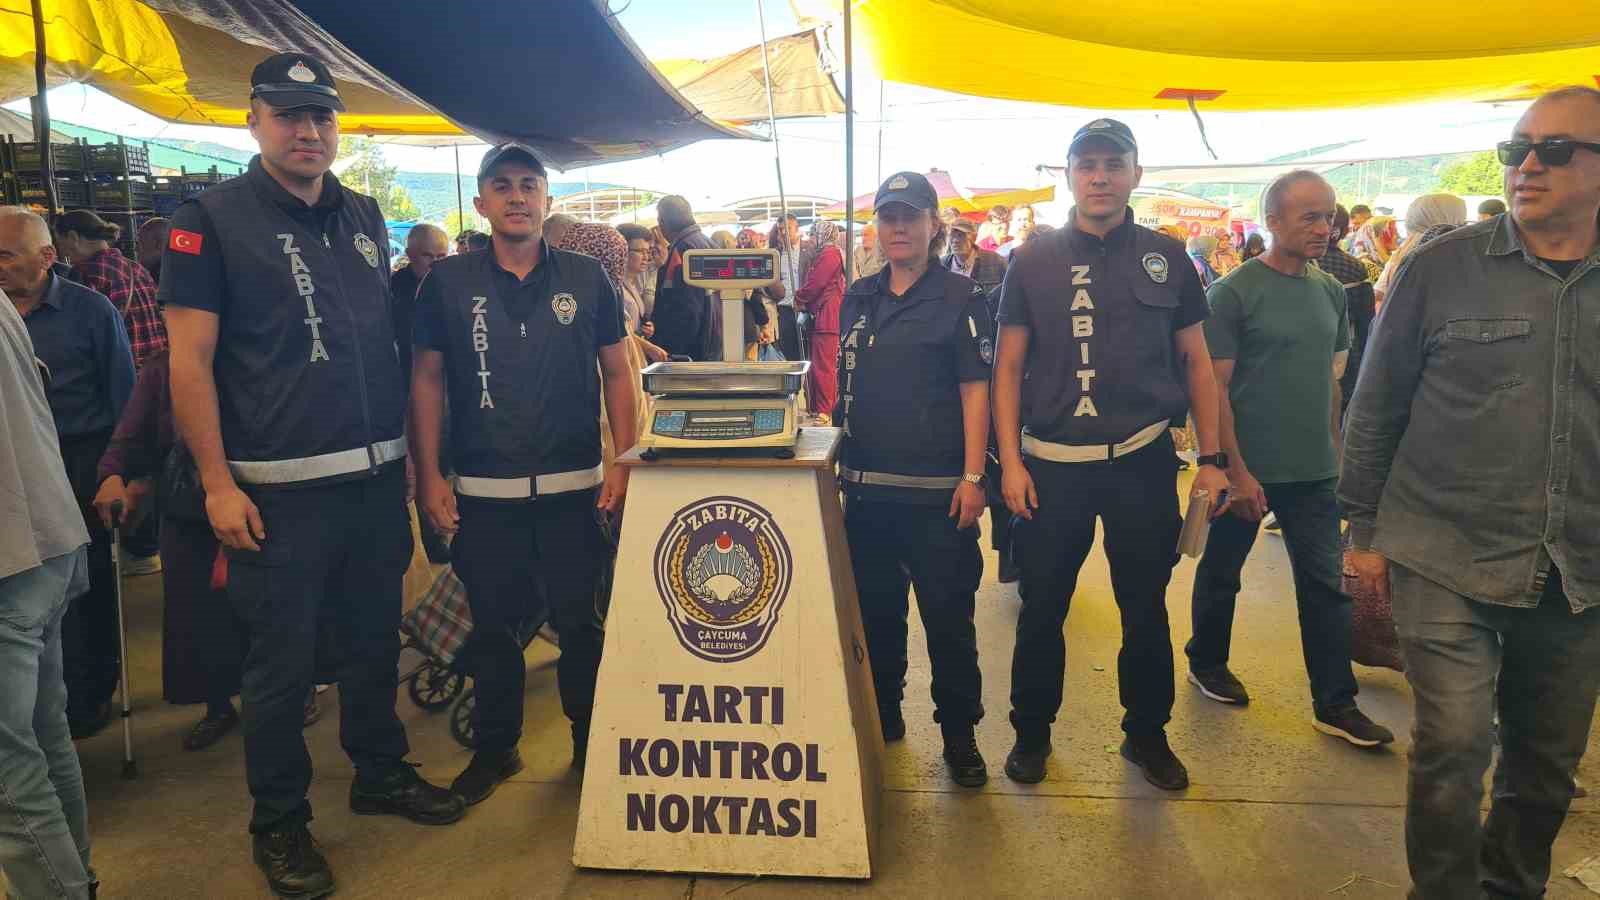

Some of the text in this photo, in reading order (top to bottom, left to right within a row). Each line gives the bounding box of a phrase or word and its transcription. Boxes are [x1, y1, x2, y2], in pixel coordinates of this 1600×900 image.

[276, 233, 331, 363] ZABITA
[472, 297, 494, 409] ZABITA
[1070, 265, 1098, 417] ZABITA
[687, 504, 760, 532] ZABITA
[697, 630, 748, 641] ÇAYCUMA
[658, 684, 784, 725] TARTI
[619, 738, 827, 782] KONTROL
[627, 793, 817, 838] NOKTASI
